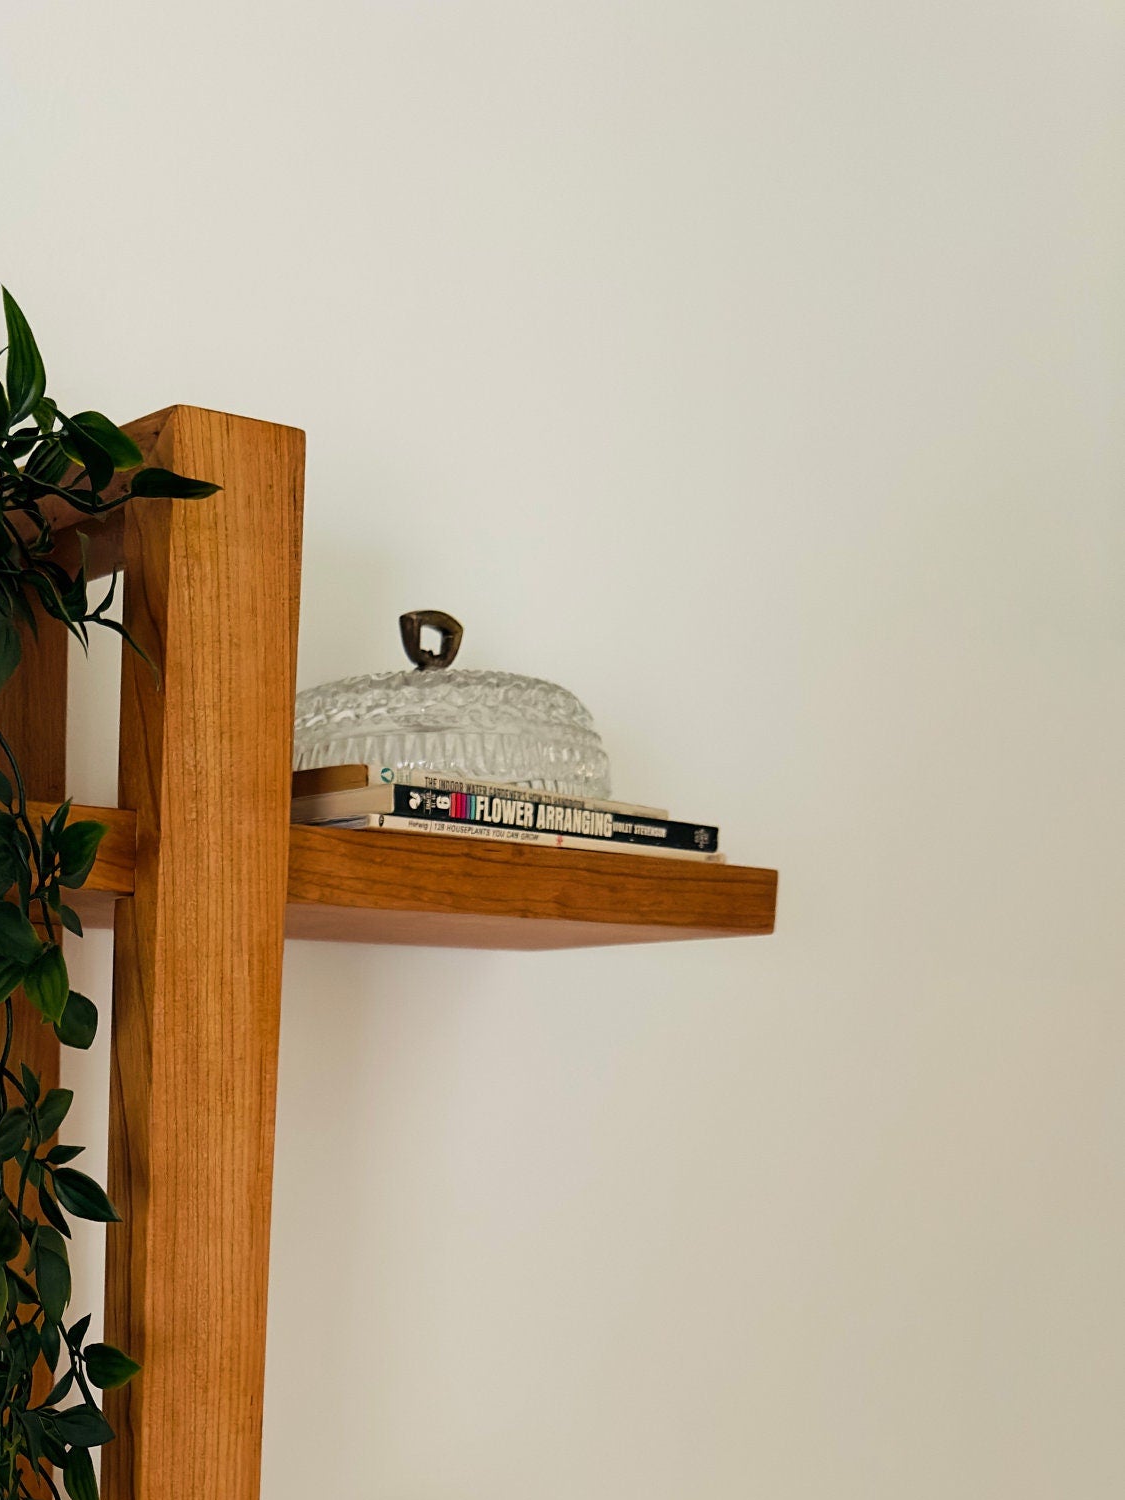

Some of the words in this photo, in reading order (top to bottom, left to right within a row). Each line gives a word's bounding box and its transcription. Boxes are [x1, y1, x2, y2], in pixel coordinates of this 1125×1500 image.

[424, 777, 437, 790] THE
[439, 778, 463, 792] INDOOR
[466, 782, 488, 795] WATER
[475, 795, 534, 828] FLOWER
[536, 804, 614, 838] ARRANGING
[446, 824, 490, 836] HOUSEPLANTS
[492, 829, 504, 838] YOU
[506, 831, 518, 839] CAN
